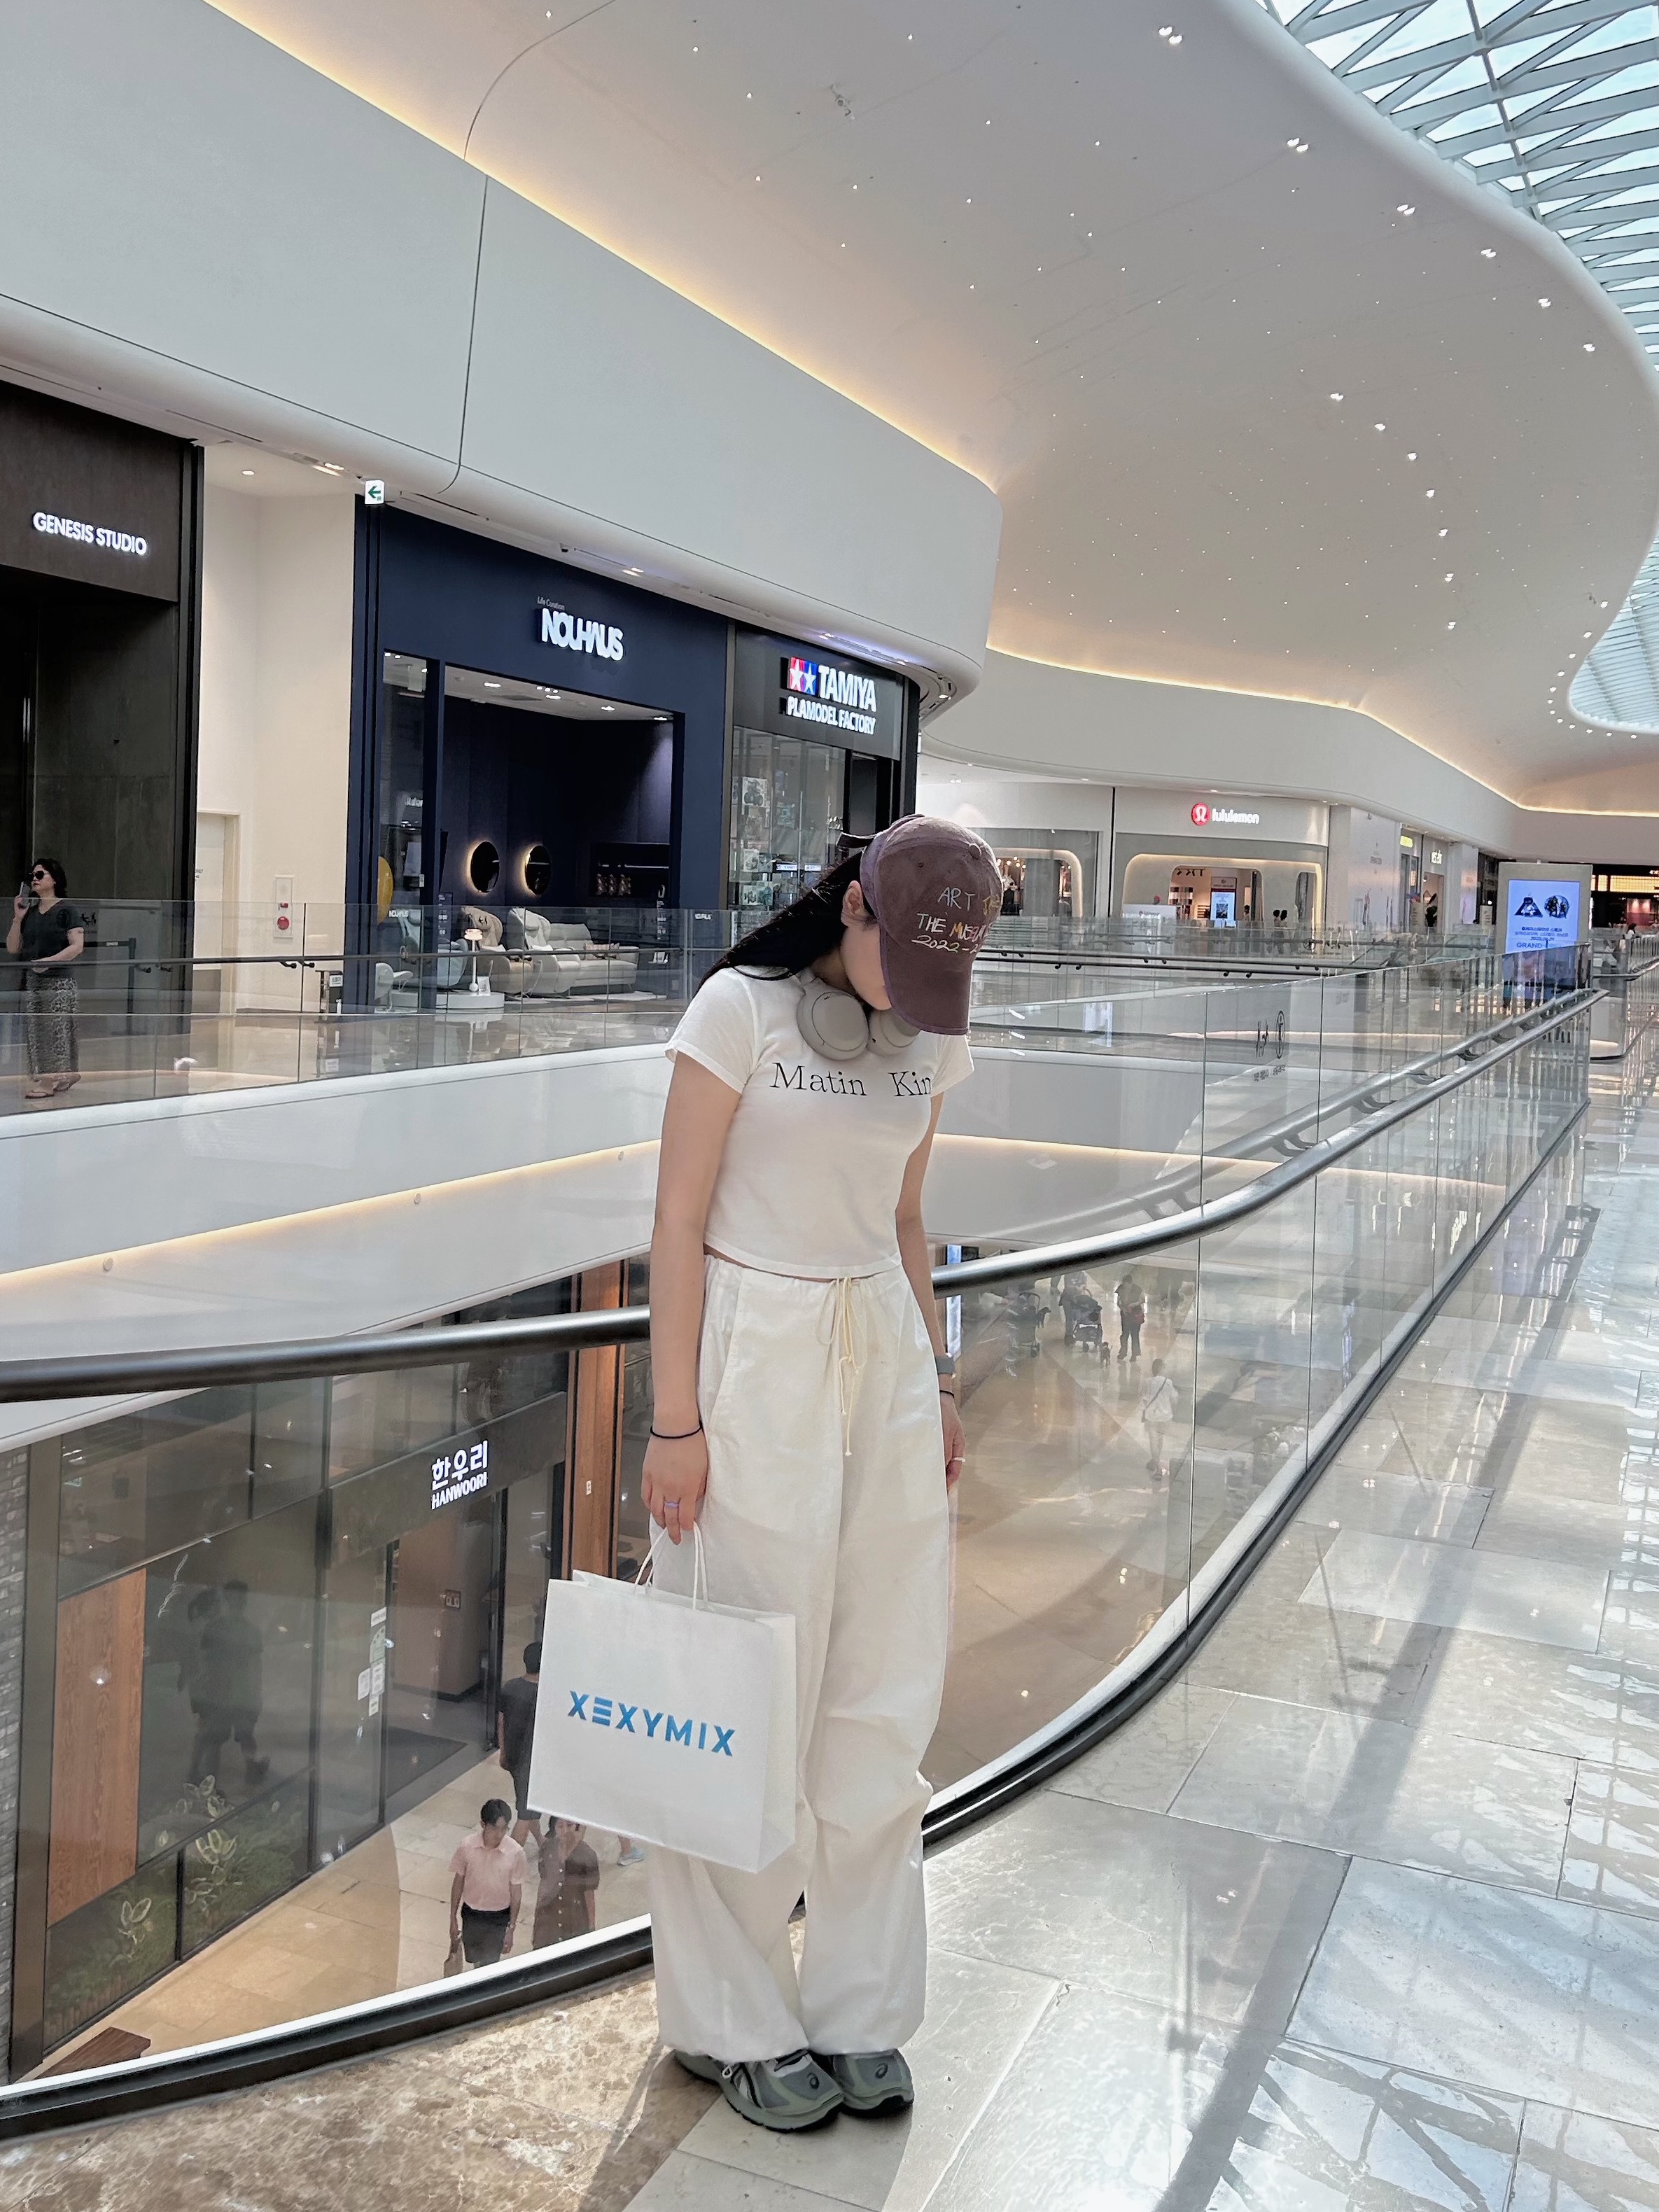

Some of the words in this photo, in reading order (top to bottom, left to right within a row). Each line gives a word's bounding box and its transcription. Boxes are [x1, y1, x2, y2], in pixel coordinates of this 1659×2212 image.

[33, 511, 94, 543] GENESIS
[95, 527, 147, 555] STUDIO
[541, 608, 624, 661] NOUHAUS
[818, 664, 877, 713] TAMIYA
[787, 695, 839, 726] PLAMODEL
[838, 708, 876, 735] FACTORY
[1212, 808, 1260, 825] lululemon
[937, 886, 976, 911] ART
[916, 912, 947, 933] THE
[769, 1062, 867, 1096] Matin
[431, 1440, 488, 1491] 한우리
[431, 1471, 487, 1510] HANWOORI
[567, 1690, 736, 1757] XEXYMIX
